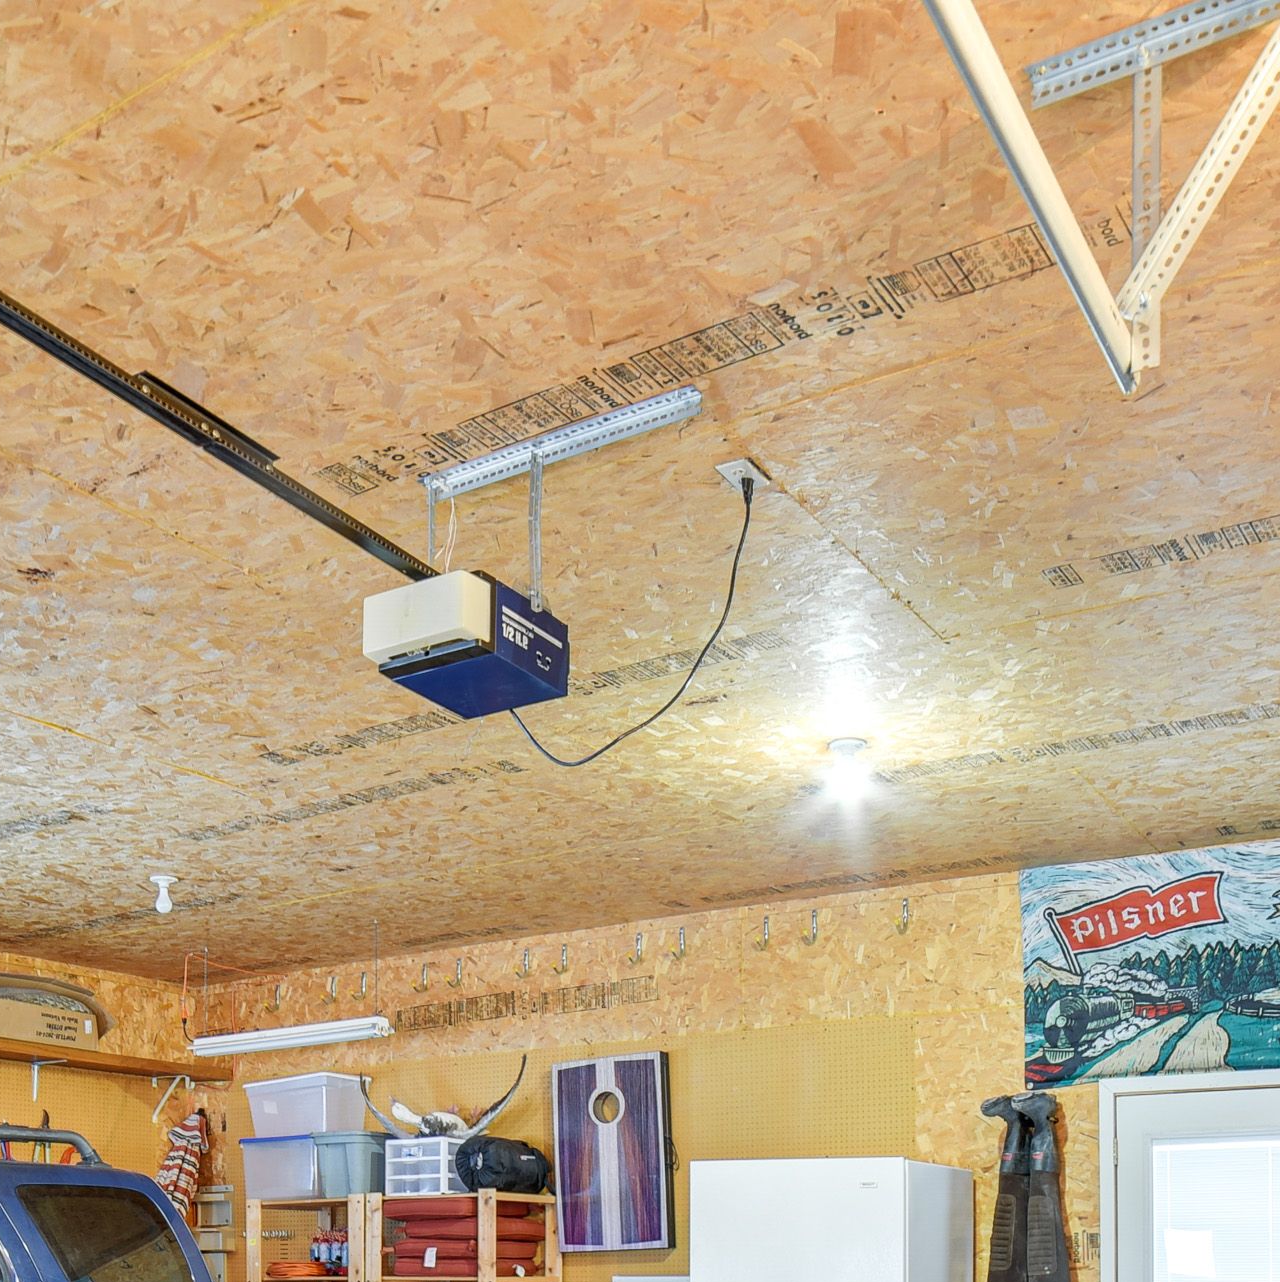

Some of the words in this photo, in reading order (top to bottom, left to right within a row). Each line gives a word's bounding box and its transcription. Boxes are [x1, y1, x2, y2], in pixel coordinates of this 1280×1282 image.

[767, 302, 812, 341] norbord
[576, 374, 623, 408] norbord
[351, 453, 399, 484] norbord
[1070, 886, 1208, 946] Pilsner
